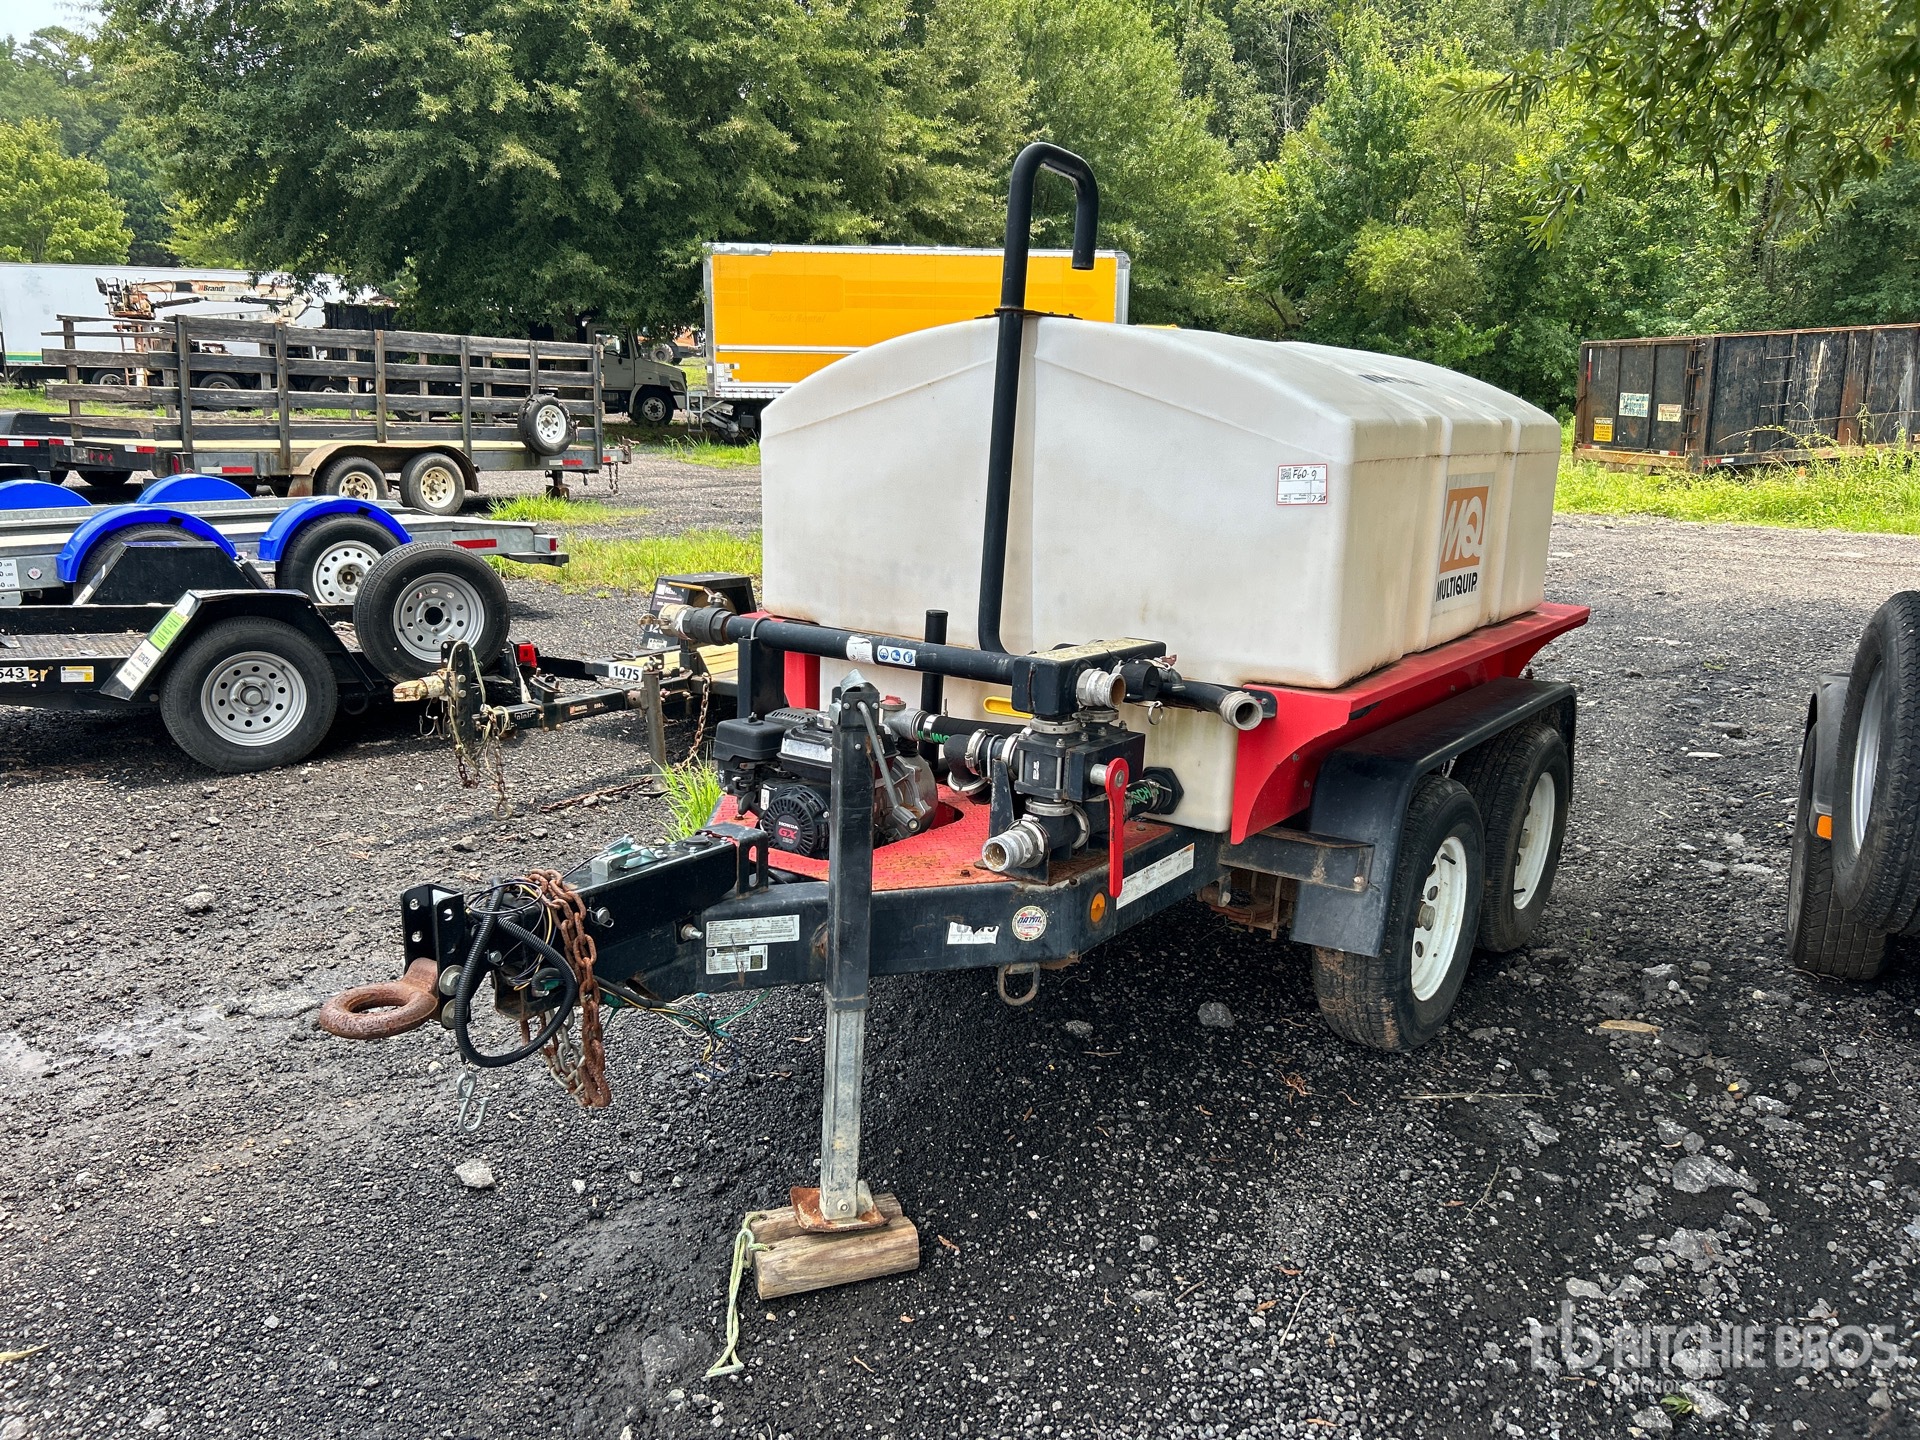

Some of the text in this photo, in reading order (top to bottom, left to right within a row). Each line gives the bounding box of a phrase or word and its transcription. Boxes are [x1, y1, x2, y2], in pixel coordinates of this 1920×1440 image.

[1436, 572, 1478, 602] MULTIQUIP
[613, 665, 640, 681] 1475
[778, 821, 799, 830] HONDA
[778, 827, 798, 839] GX
